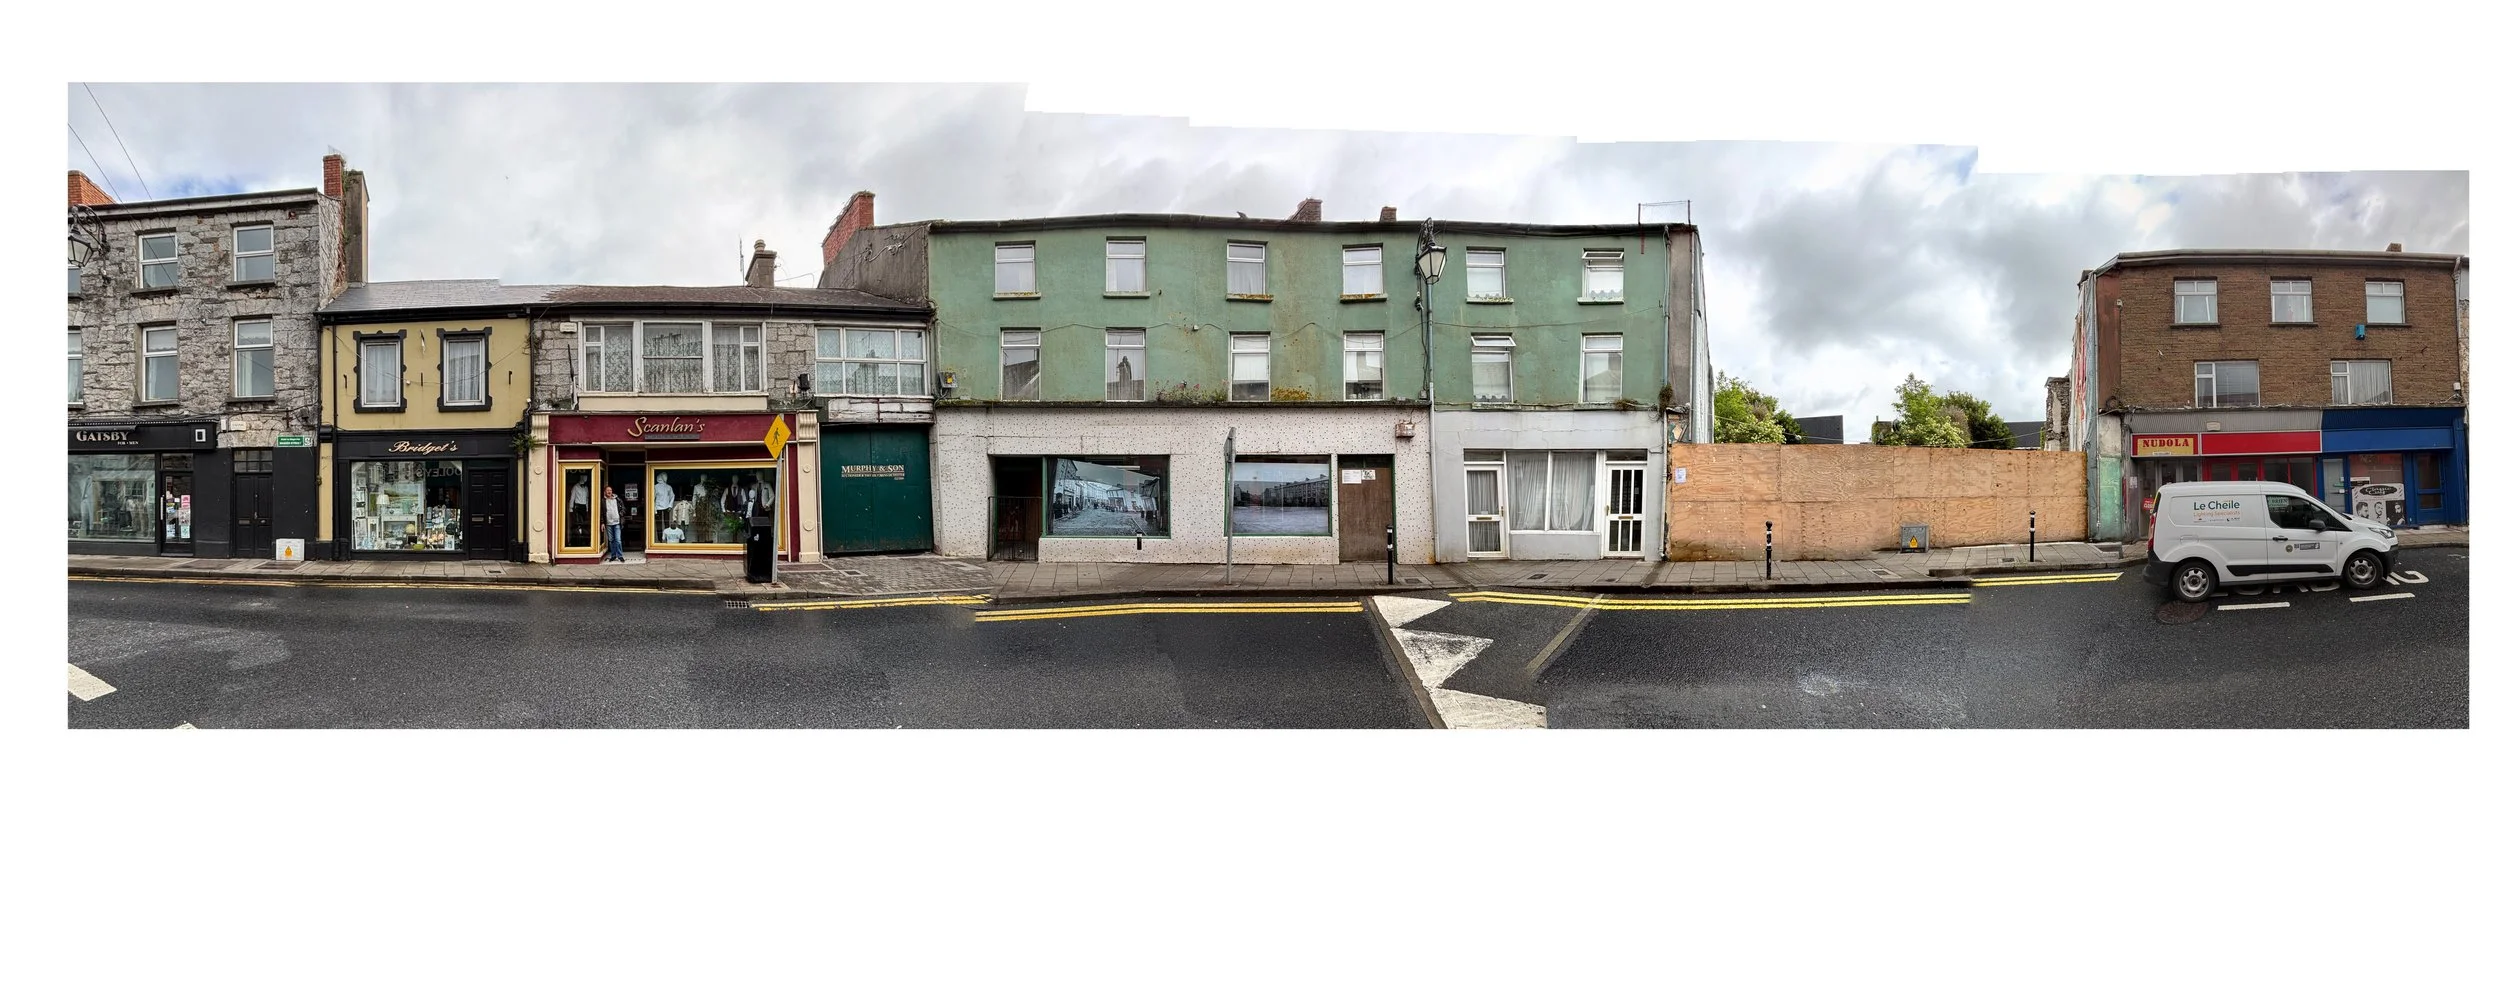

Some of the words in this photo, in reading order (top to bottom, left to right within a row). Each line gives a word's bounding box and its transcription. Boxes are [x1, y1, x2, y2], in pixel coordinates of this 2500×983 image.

[627, 416, 706, 437] Scanlan's
[76, 430, 129, 442] GATSBY
[388, 440, 459, 455] Bridget's
[2142, 438, 2190, 448] NUDOLA
[841, 464, 877, 473] MURPHY
[887, 464, 904, 473] SON
[2193, 502, 2206, 511] Le
[2193, 510, 2214, 518] Lighting
